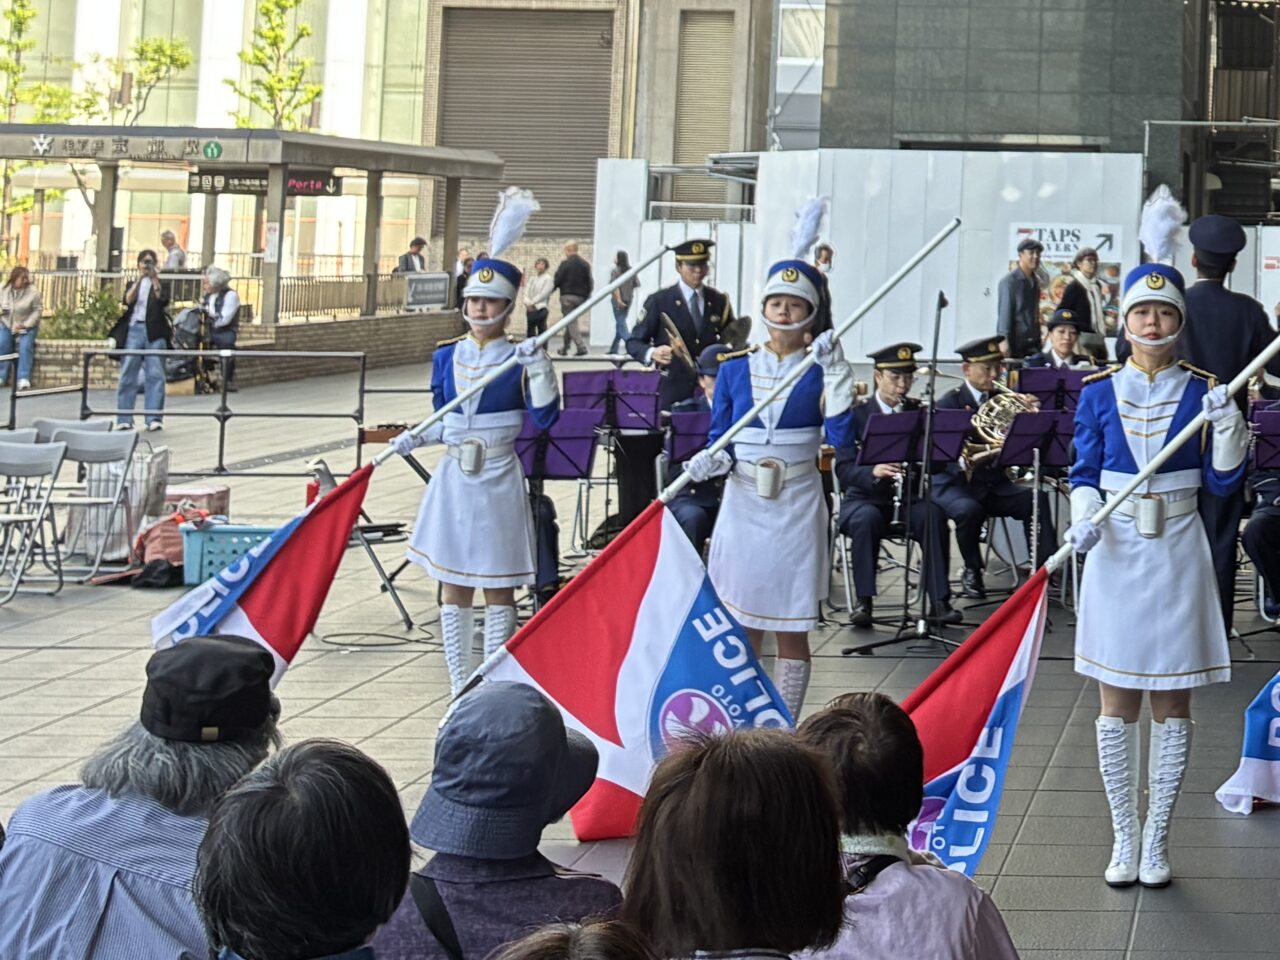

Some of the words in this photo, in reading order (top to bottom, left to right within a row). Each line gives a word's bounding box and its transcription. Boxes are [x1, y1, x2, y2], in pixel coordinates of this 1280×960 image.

[288, 178, 323, 190] Porta
[1036, 228, 1081, 242] TAPS
[1045, 243, 1080, 251] VERN
[692, 607, 794, 730] OLICE
[711, 684, 746, 730] YOTO
